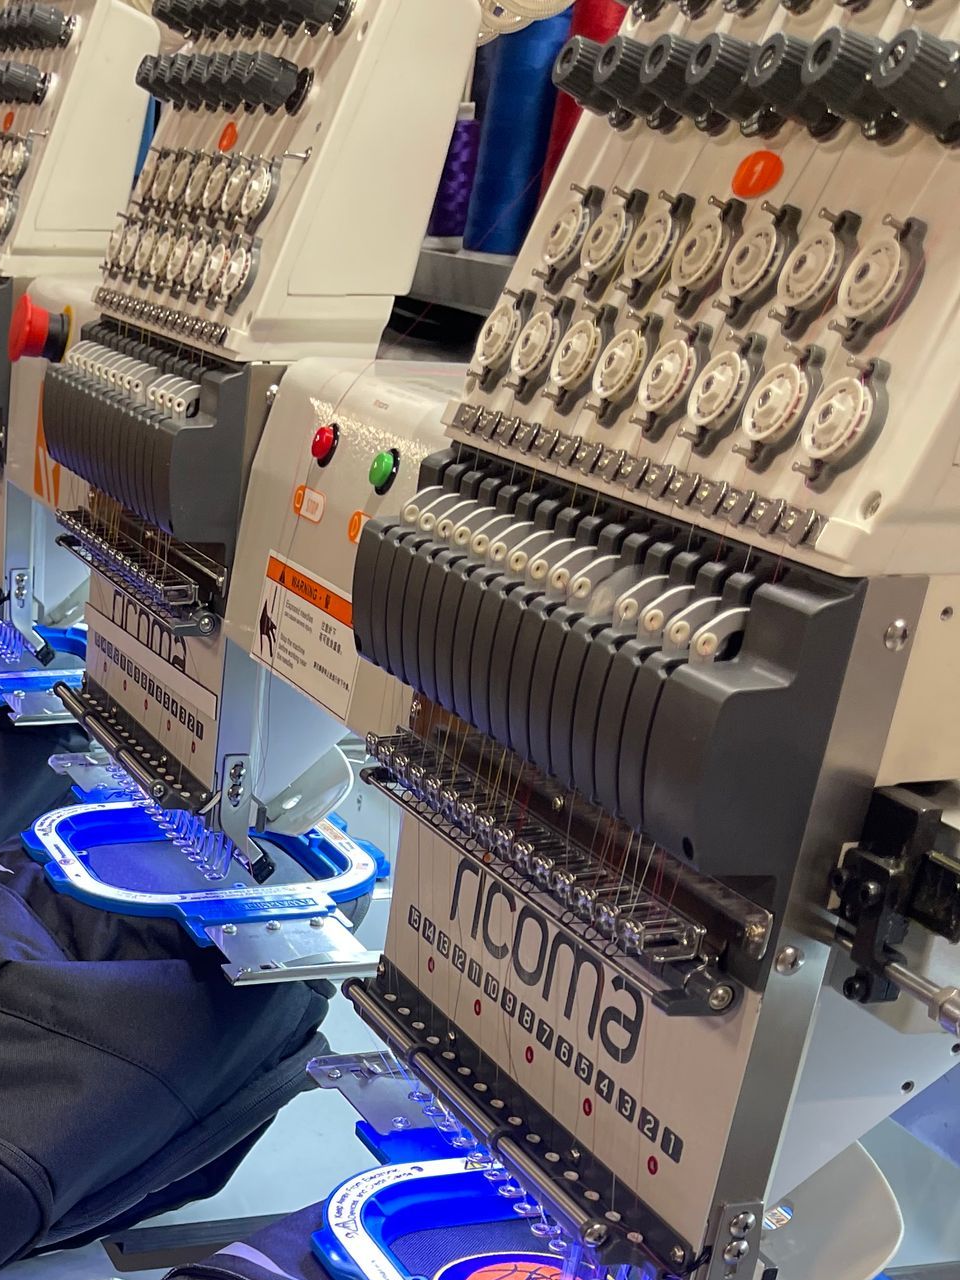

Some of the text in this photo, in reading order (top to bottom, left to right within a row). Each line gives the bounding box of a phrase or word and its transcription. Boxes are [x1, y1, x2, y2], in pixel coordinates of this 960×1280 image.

[292, 576, 318, 600] WARNING
[410, 907, 420, 929] 15
[424, 919, 435, 944] 14
[439, 932, 450, 956] 13
[454, 946, 465, 970] 12
[470, 961, 480, 984] 11
[486, 974, 498, 1000] 10
[504, 992, 514, 1012] 9
[522, 1008, 532, 1029] 8
[541, 1023, 552, 1044] 7
[560, 1041, 570, 1062] 6
[579, 1057, 590, 1079] 5
[599, 1078, 610, 1097] 4
[621, 1094, 632, 1116] 3
[642, 1114, 655, 1138] 2
[449, 858, 645, 1064] ricoma
